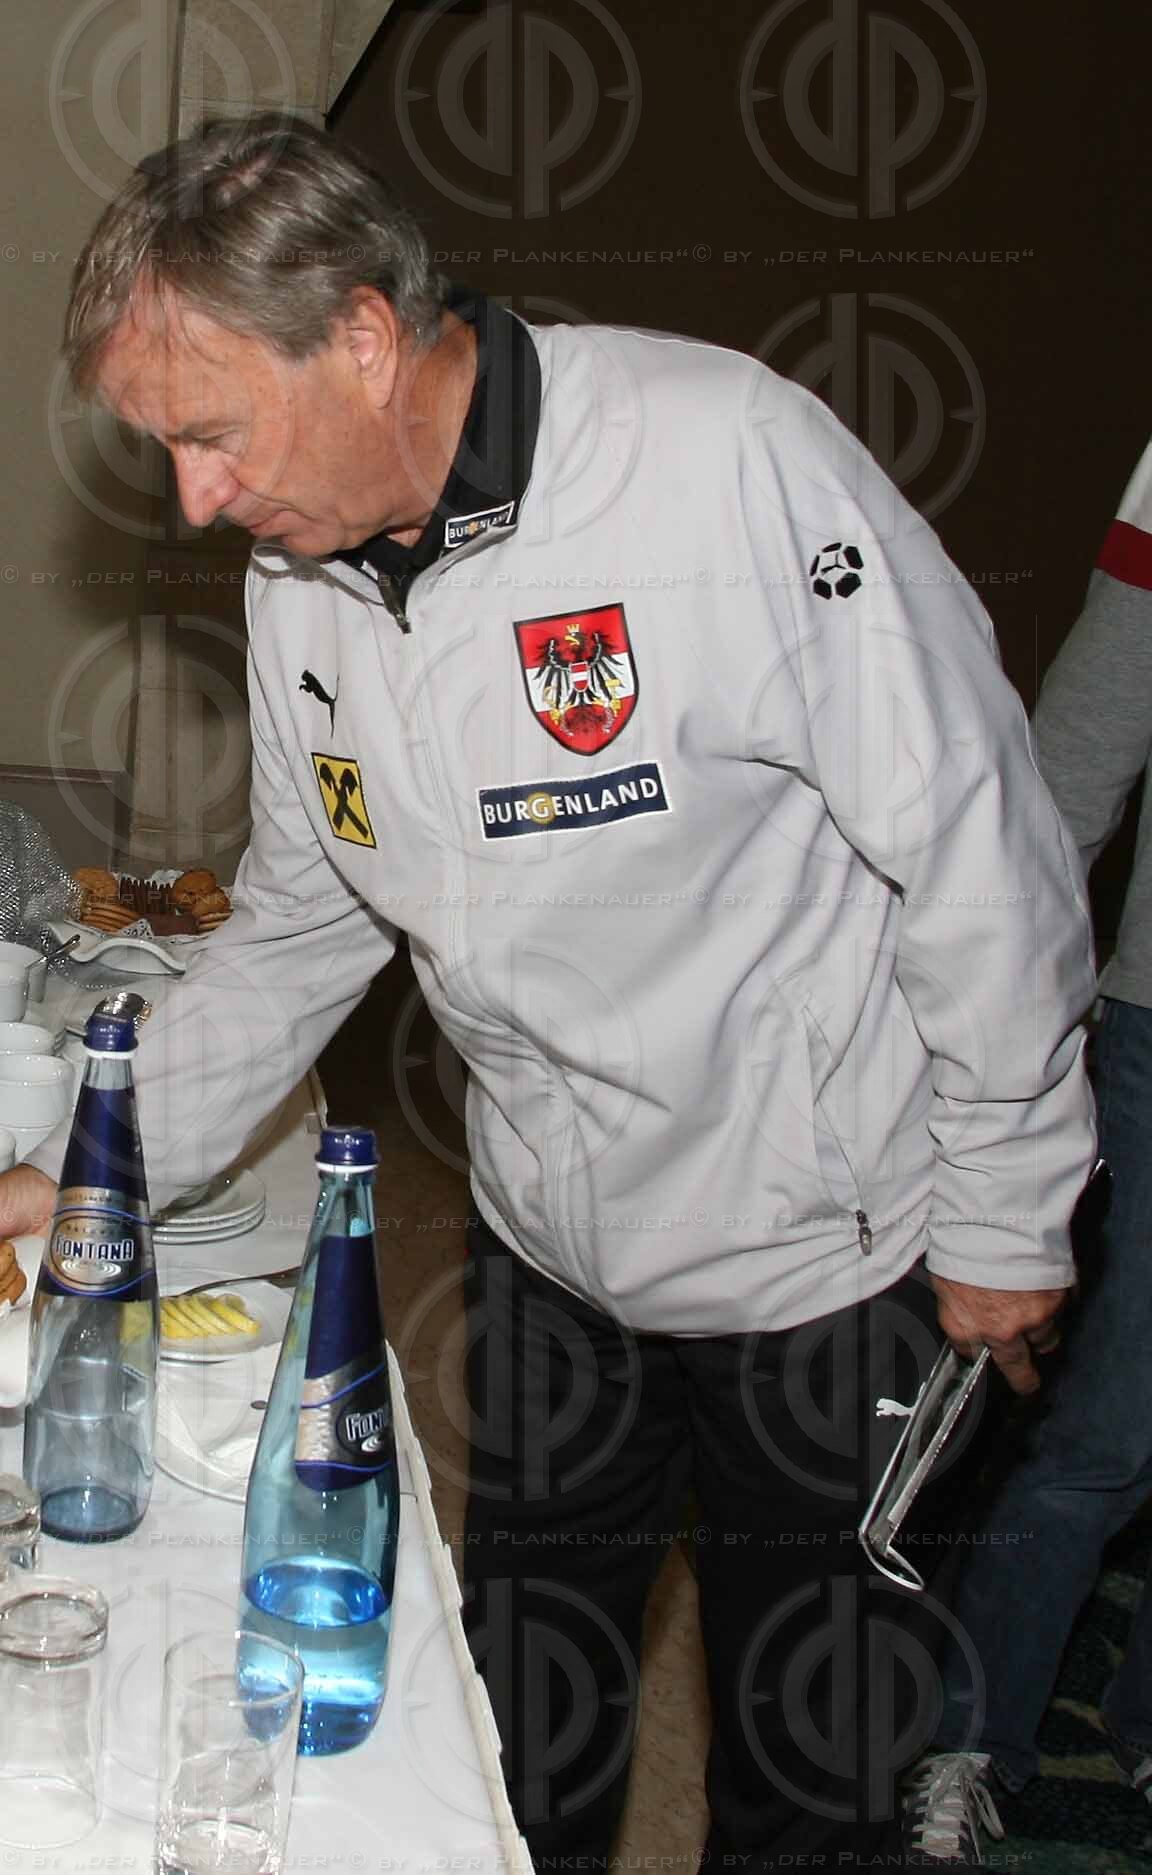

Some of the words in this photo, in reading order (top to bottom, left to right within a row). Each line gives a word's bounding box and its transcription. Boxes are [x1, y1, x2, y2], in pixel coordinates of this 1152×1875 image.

[448, 511, 509, 539] BURNLAN
[483, 777, 659, 825] BURGENLAND
[55, 1234, 135, 1261] FONTANA
